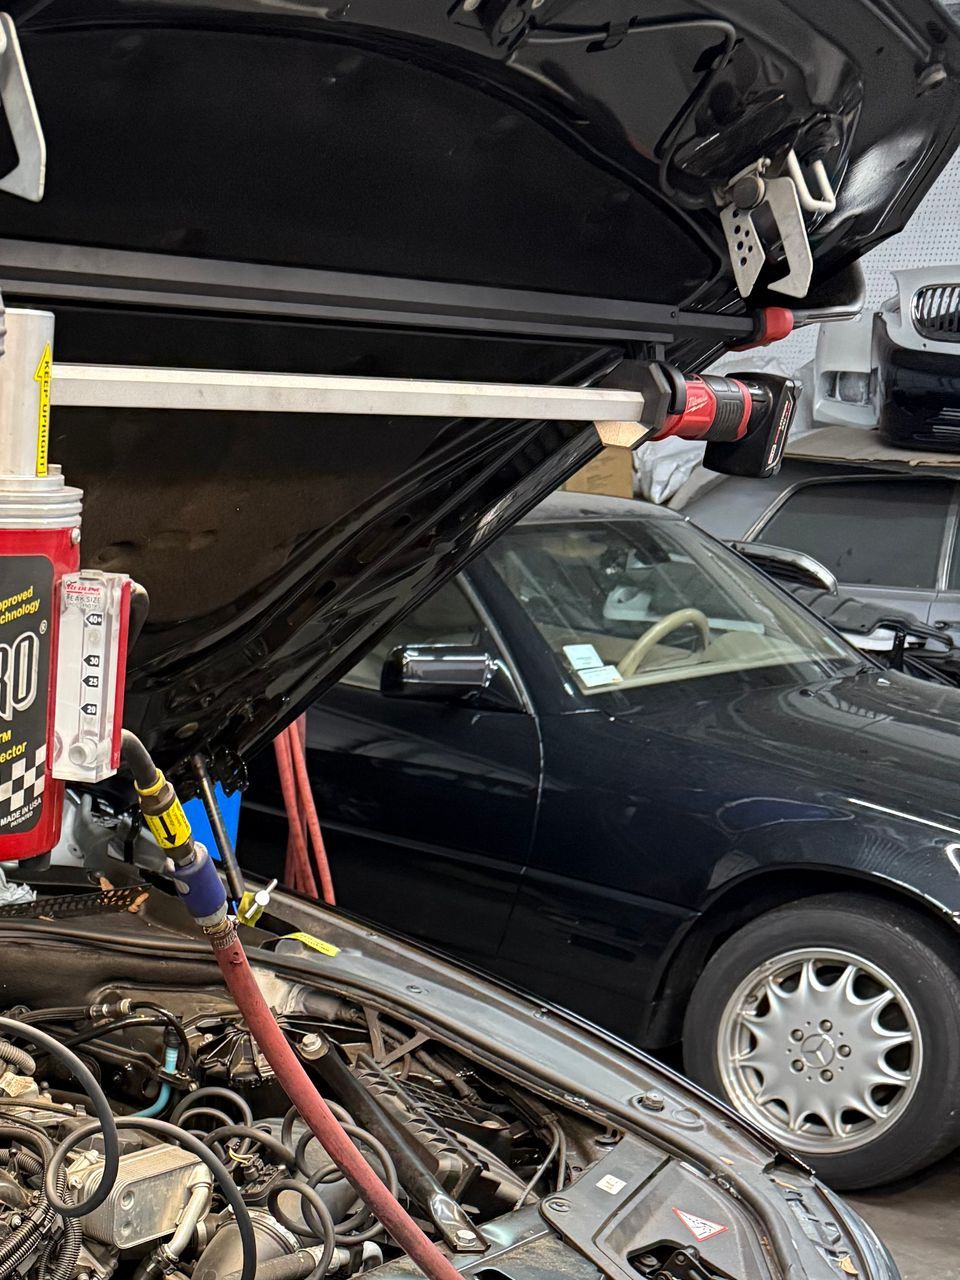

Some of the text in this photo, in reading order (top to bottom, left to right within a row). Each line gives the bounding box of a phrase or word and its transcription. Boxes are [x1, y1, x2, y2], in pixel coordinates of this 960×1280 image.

[89, 656, 99, 666] 30
[88, 677, 98, 687] 25
[86, 705, 96, 715] 20
[0, 796, 43, 827] MADE IN USA
